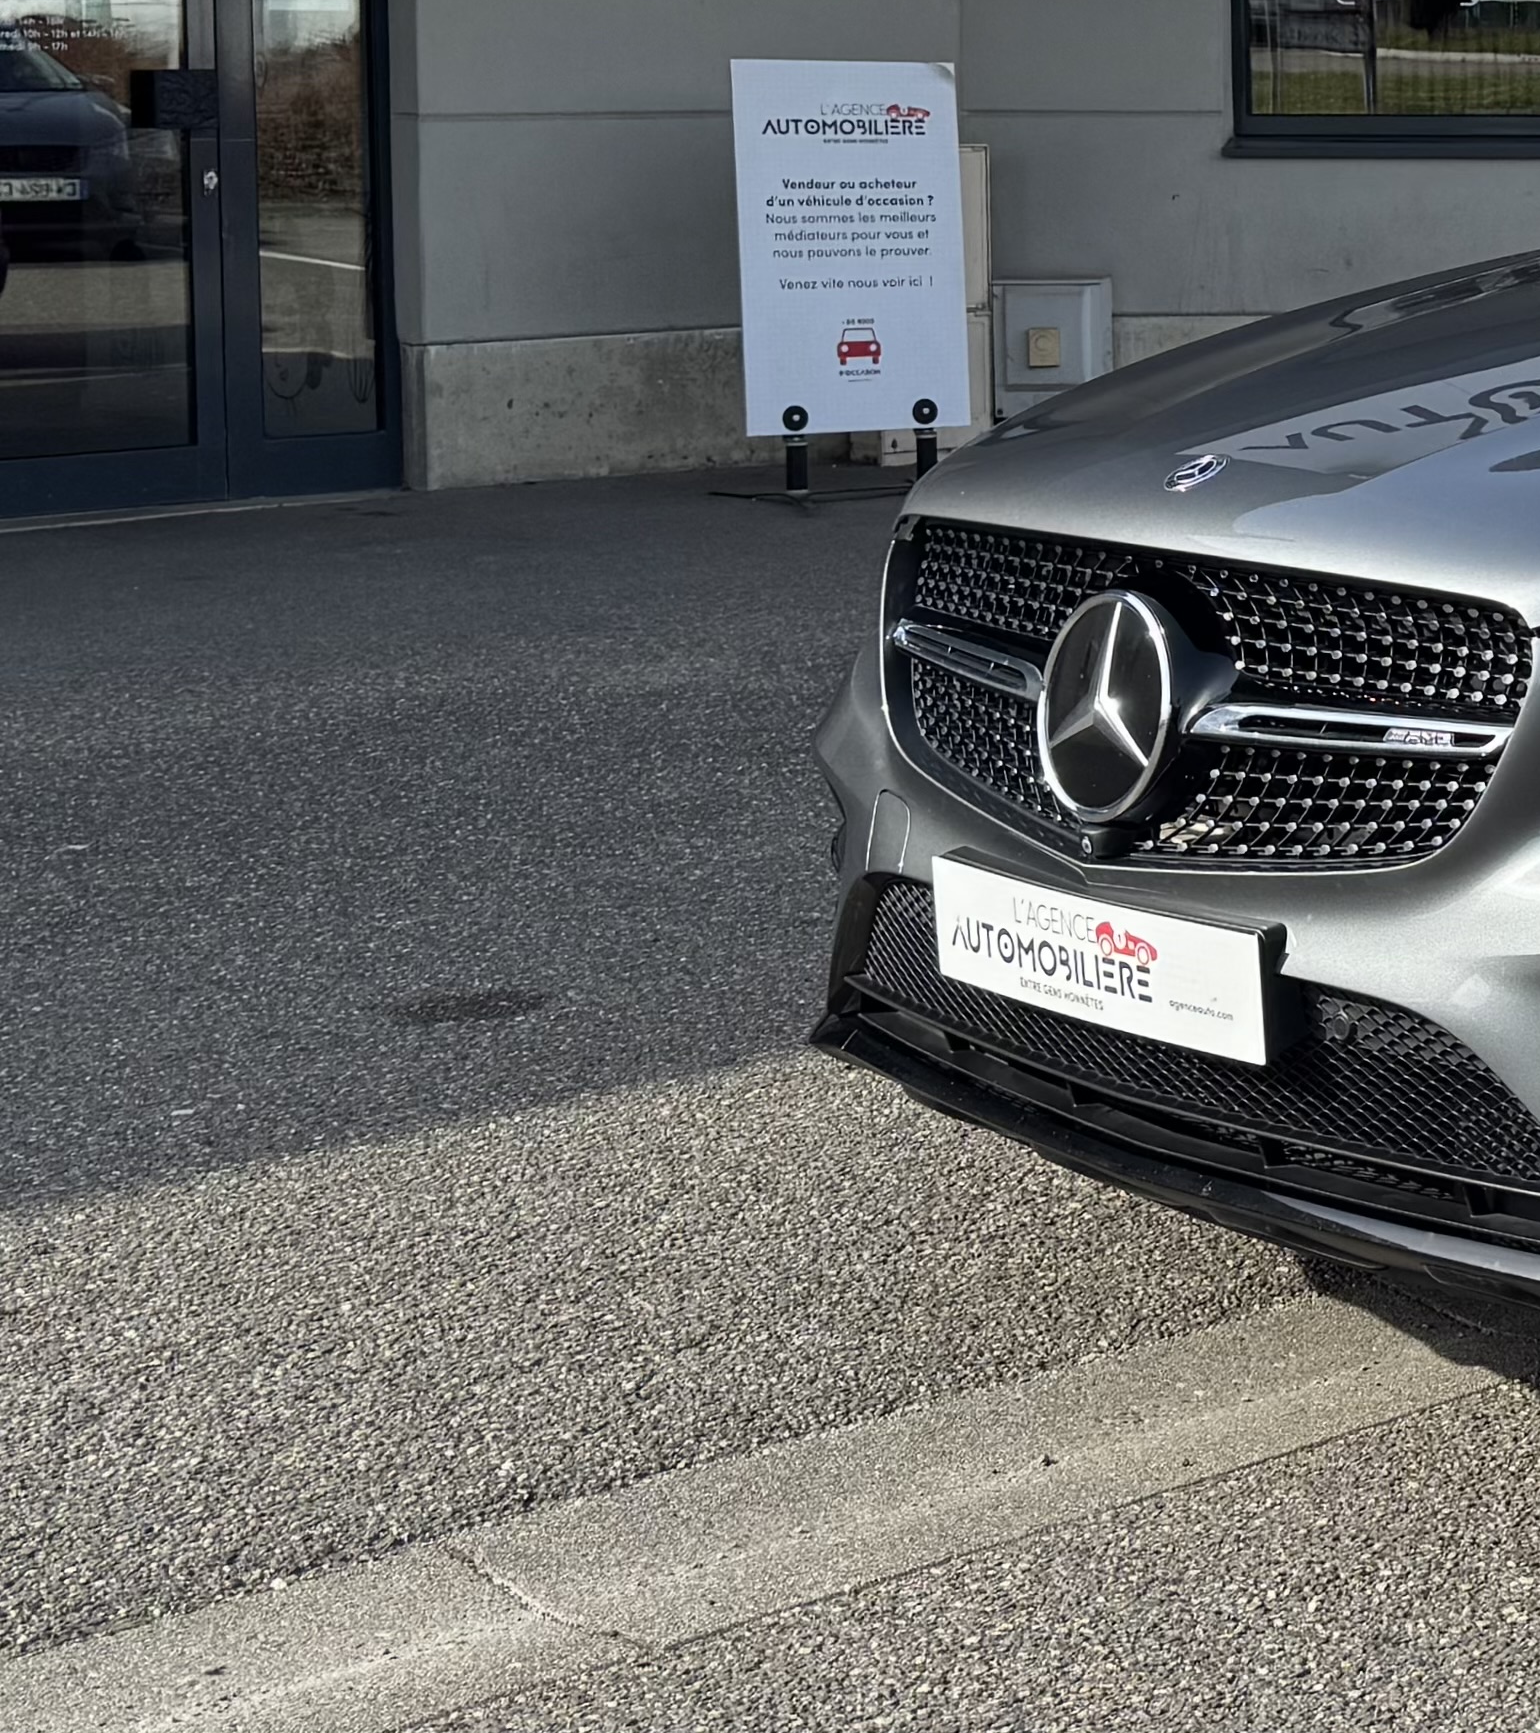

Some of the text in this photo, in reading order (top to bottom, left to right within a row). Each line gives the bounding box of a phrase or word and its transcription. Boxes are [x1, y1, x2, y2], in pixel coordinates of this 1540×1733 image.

[782, 178, 917, 190] Vendeur ou acheteur
[765, 212, 936, 224] Nous sommes les meilleurs
[851, 232, 881, 243] pour
[885, 231, 914, 240] vous
[773, 249, 804, 259] nous
[807, 249, 862, 260] pouvons
[779, 278, 818, 290] Venez
[821, 277, 844, 289] vite
[848, 279, 878, 289] nous
[882, 277, 906, 288] voir
[1013, 896, 1096, 943] L'AGENCE
